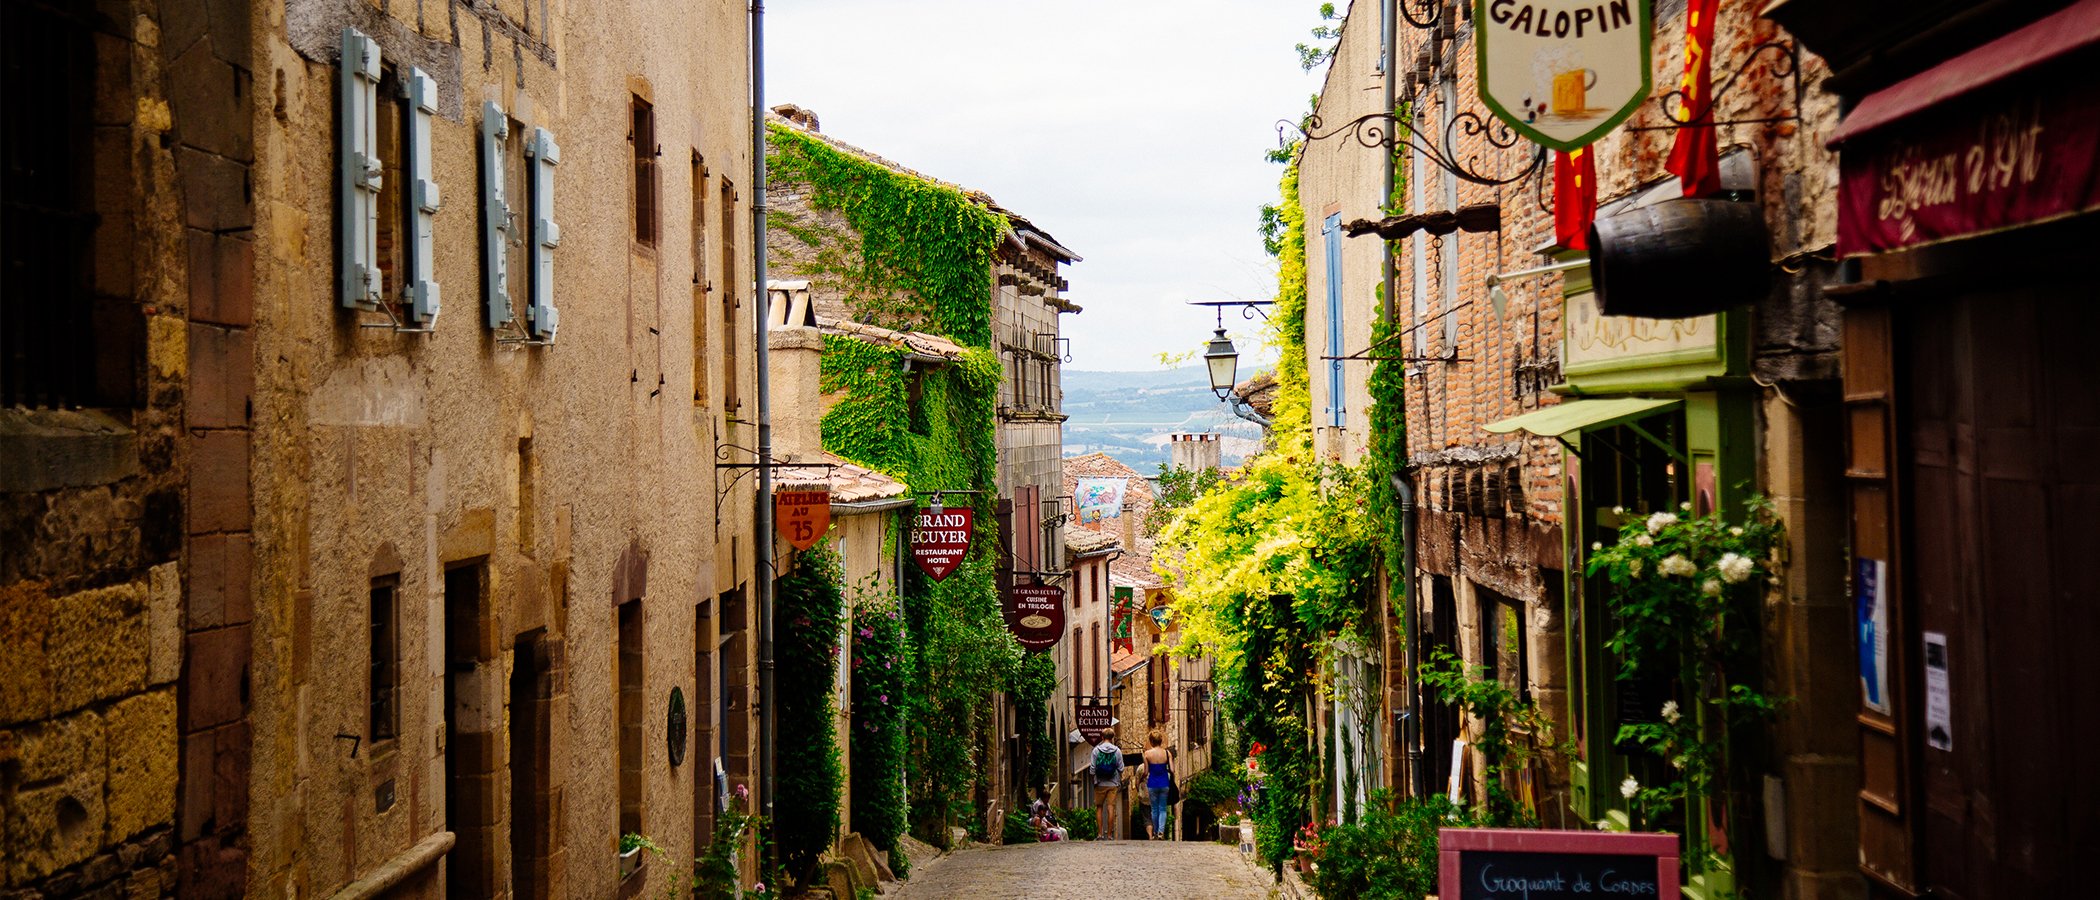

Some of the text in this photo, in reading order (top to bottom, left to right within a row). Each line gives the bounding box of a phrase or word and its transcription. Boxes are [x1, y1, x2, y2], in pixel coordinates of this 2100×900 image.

[1490, 0, 1632, 39] GALOPIN
[791, 507, 809, 517] AU
[914, 514, 966, 528] GRAND
[911, 528, 969, 544] ÉCUYER
[915, 548, 964, 556] RESTAURANT
[1079, 709, 1109, 717] GRAND
[1078, 716, 1110, 726] ÉCUYER
[1480, 863, 1566, 900] Croquant
[1571, 873, 1593, 894] de
